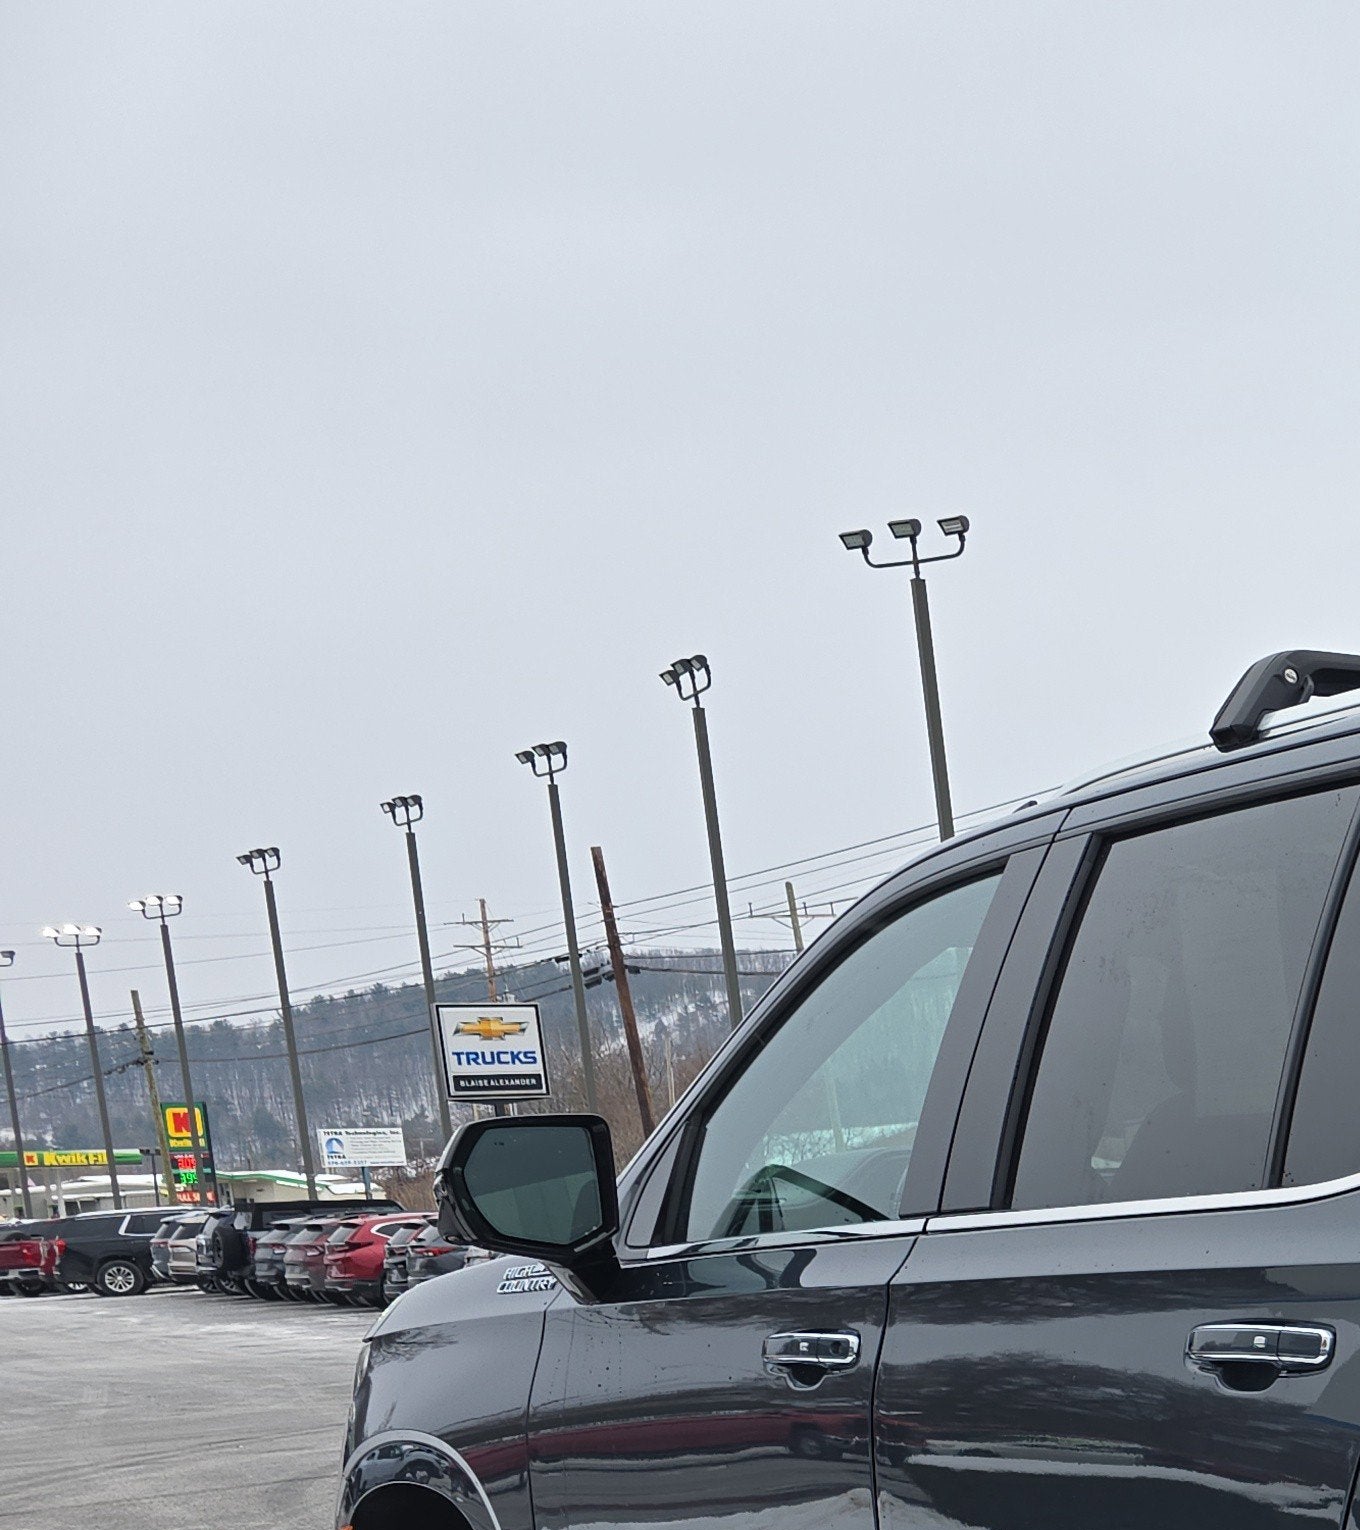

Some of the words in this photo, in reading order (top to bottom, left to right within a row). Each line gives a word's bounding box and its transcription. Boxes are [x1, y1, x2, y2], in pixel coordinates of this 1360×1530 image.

[452, 1050, 538, 1066] TRUCKS
[460, 1079, 489, 1087] BLAISE
[490, 1078, 537, 1086] ALEXANDER
[497, 1277, 557, 1295] COUNTRY
